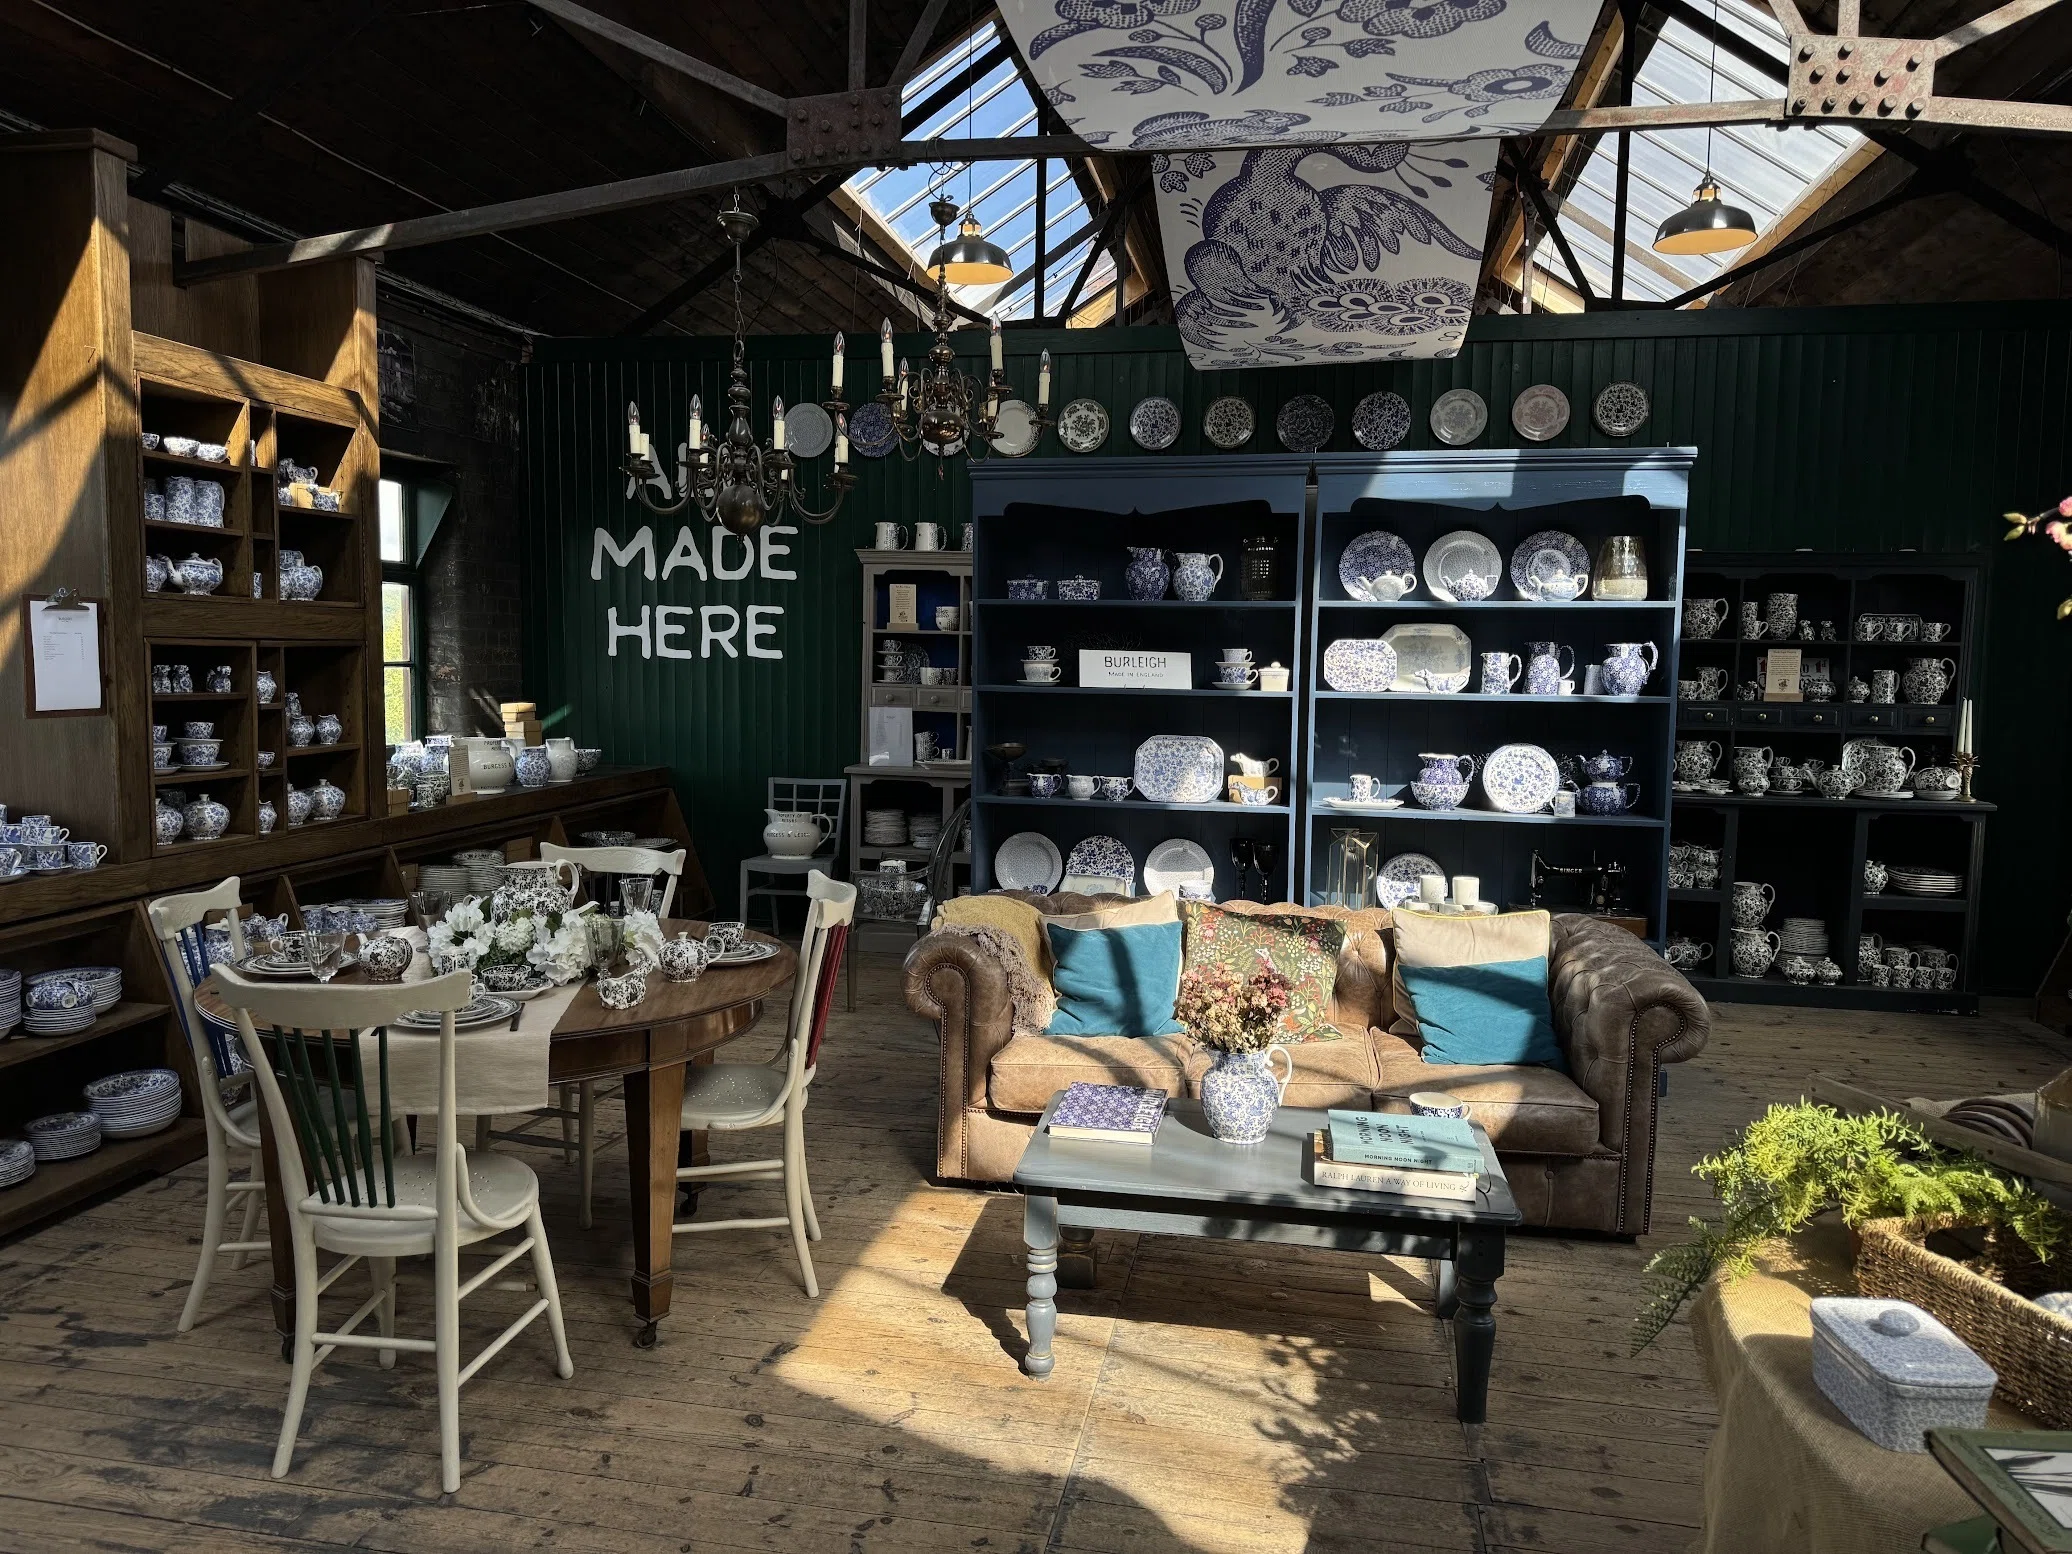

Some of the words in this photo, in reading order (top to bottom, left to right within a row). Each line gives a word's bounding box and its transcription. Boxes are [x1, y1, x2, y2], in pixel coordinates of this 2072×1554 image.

[591, 526, 798, 581] MADE
[608, 605, 784, 659] HERE
[1104, 656, 1167, 668] BURLEIGH
[1355, 1116, 1374, 1145] MORNING
[1376, 1123, 1394, 1143] NOON
[1395, 1124, 1414, 1145] NIGHT
[1364, 1153, 1393, 1162] MORNING
[1321, 1171, 1349, 1181] RALPH
[1350, 1174, 1384, 1184] LAUREN
[1385, 1177, 1392, 1185] A
[1393, 1178, 1411, 1186] WAY
[1412, 1180, 1425, 1188] OF
[1426, 1181, 1457, 1191] LIVING
